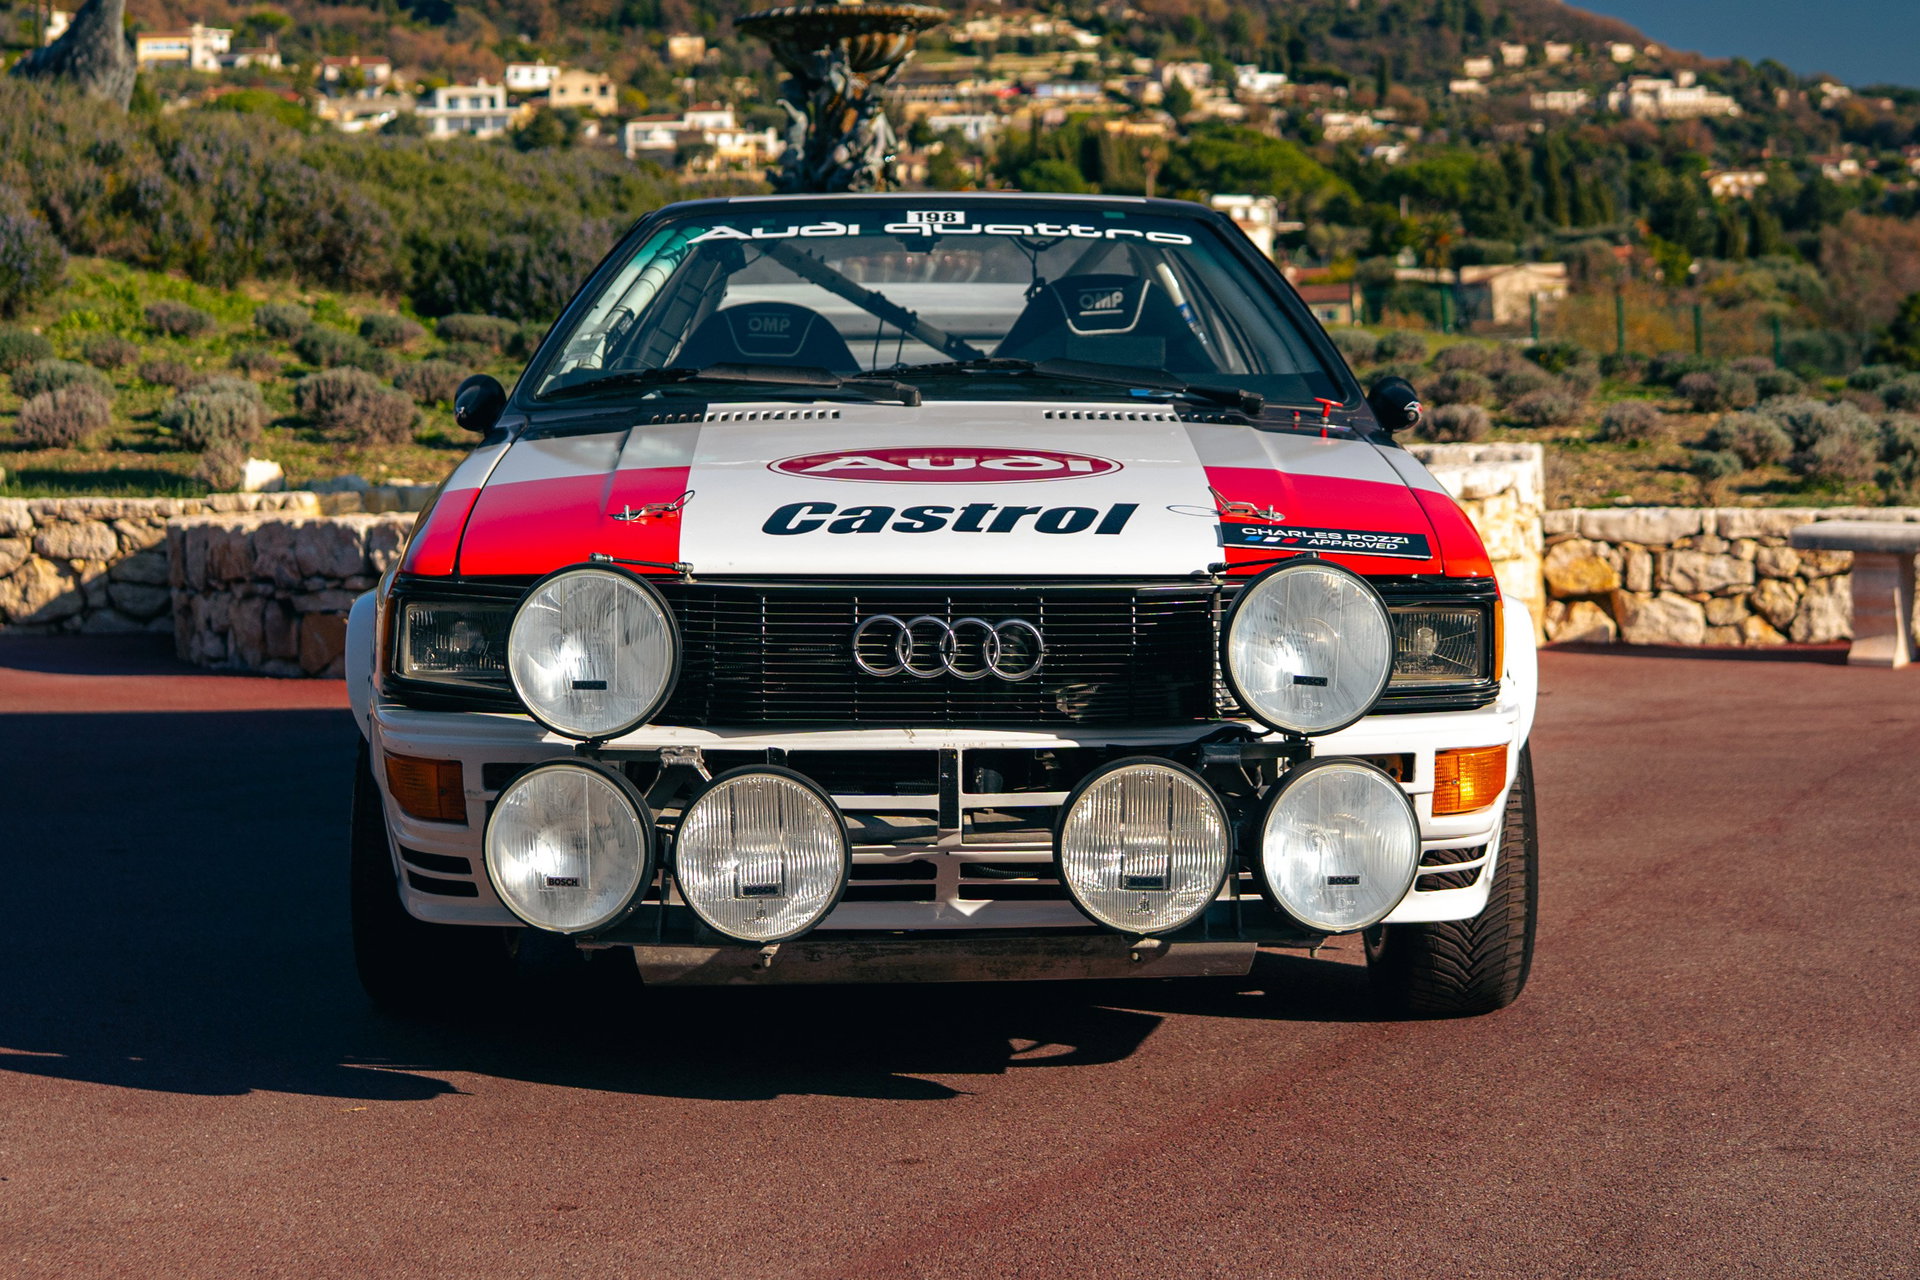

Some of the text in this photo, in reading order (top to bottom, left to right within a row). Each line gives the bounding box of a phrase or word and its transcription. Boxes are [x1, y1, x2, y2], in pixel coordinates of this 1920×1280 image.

[917, 212, 956, 222] 198
[686, 221, 1193, 245] Audi quattro
[1079, 291, 1123, 309] OMP
[748, 317, 791, 332] OMP
[801, 455, 1094, 473] Audi
[762, 501, 1140, 535] Castrol
[1241, 527, 1409, 544] CHARLES POZZI
[1307, 538, 1398, 550] APPROVED
[548, 878, 578, 886] BOSCH
[1330, 876, 1359, 885] BOSCH
[745, 885, 778, 894] BOSCH
